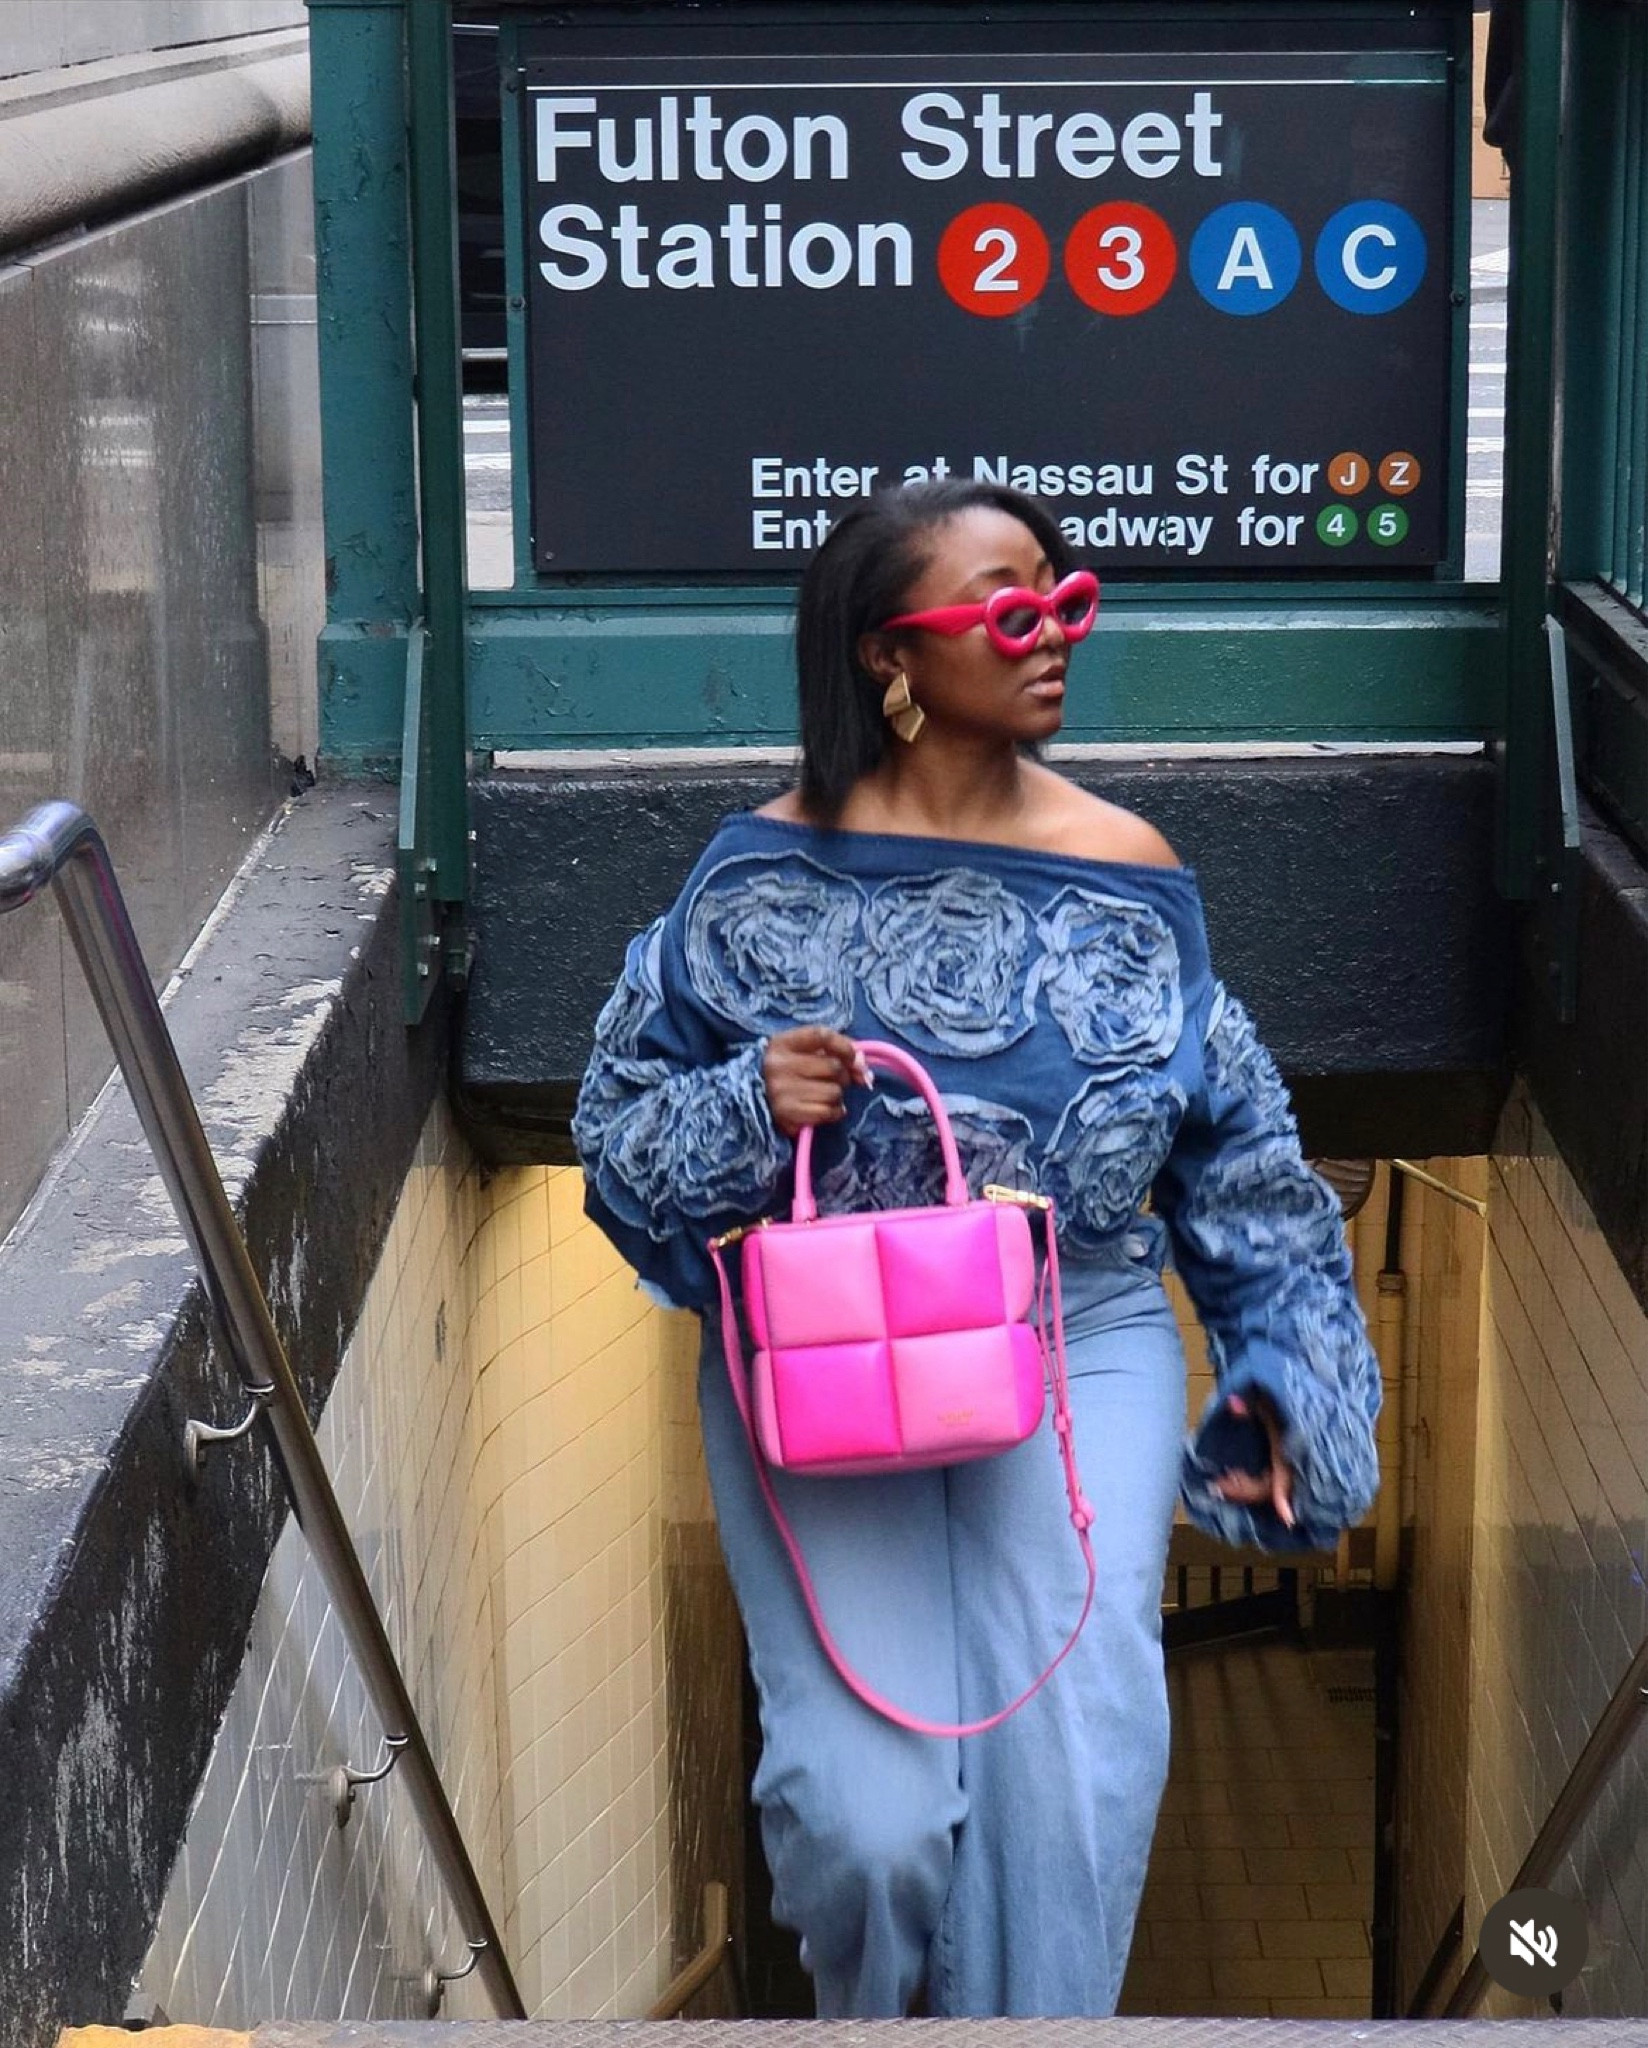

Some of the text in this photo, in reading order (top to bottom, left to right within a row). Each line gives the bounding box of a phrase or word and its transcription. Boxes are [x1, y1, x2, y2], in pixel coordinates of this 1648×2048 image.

[536, 92, 1223, 183] Fulton Street
[539, 203, 1397, 292] Station 2 3 A C
[752, 454, 1410, 497] Enter at Nassau St for J Z
[752, 506, 1397, 556] Ent adway for 4 5
